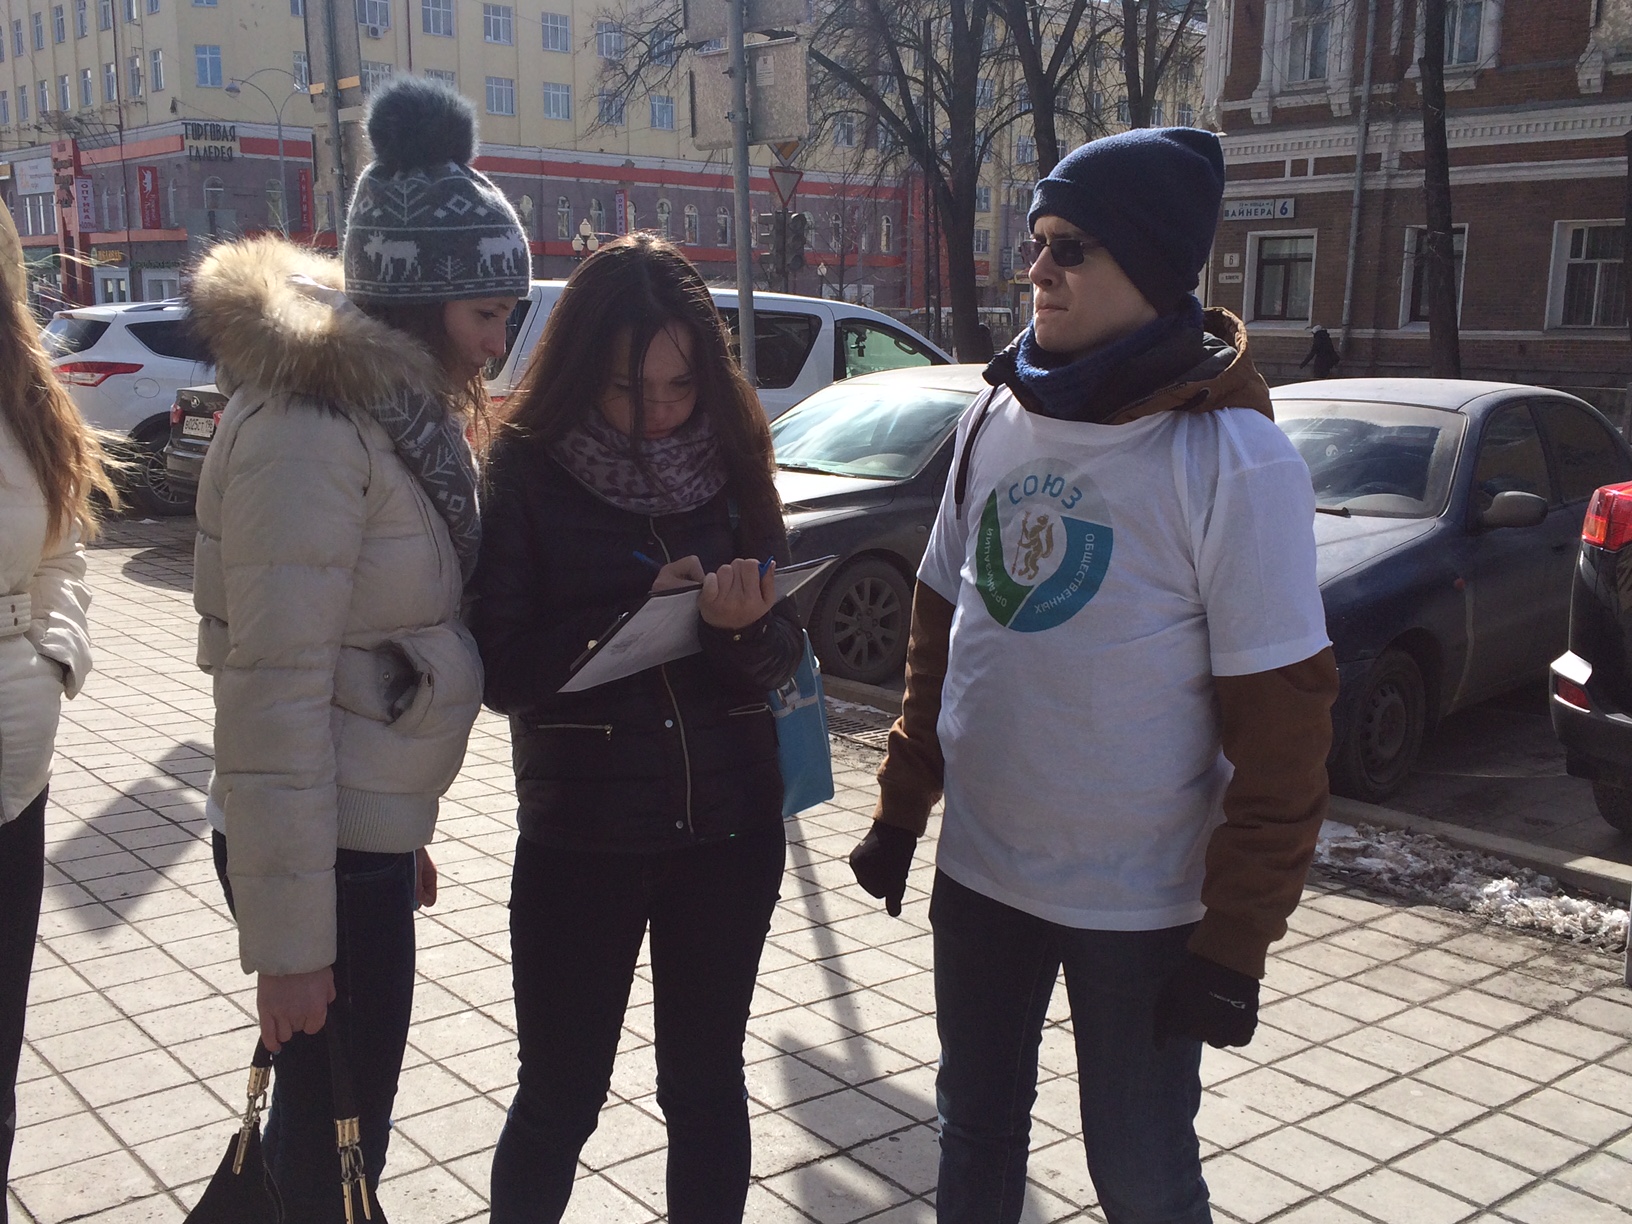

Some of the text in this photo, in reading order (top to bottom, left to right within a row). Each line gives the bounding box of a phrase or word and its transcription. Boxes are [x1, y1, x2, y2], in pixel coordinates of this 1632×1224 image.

[182, 122, 236, 142] ТОРГОВАЯ
[188, 145, 234, 162] ГАЛЕРЕЯ
[80, 183, 91, 220] ОПТИКА
[1224, 201, 1288, 217] ВАЙНЕРА 6
[1229, 255, 1234, 265] 6
[1008, 473, 1083, 510] СОЮЗ
[982, 528, 1008, 608] ОРГАНИЗАЦИЙ
[1034, 533, 1095, 615] ОБЩЕСТВЕННЫХ
